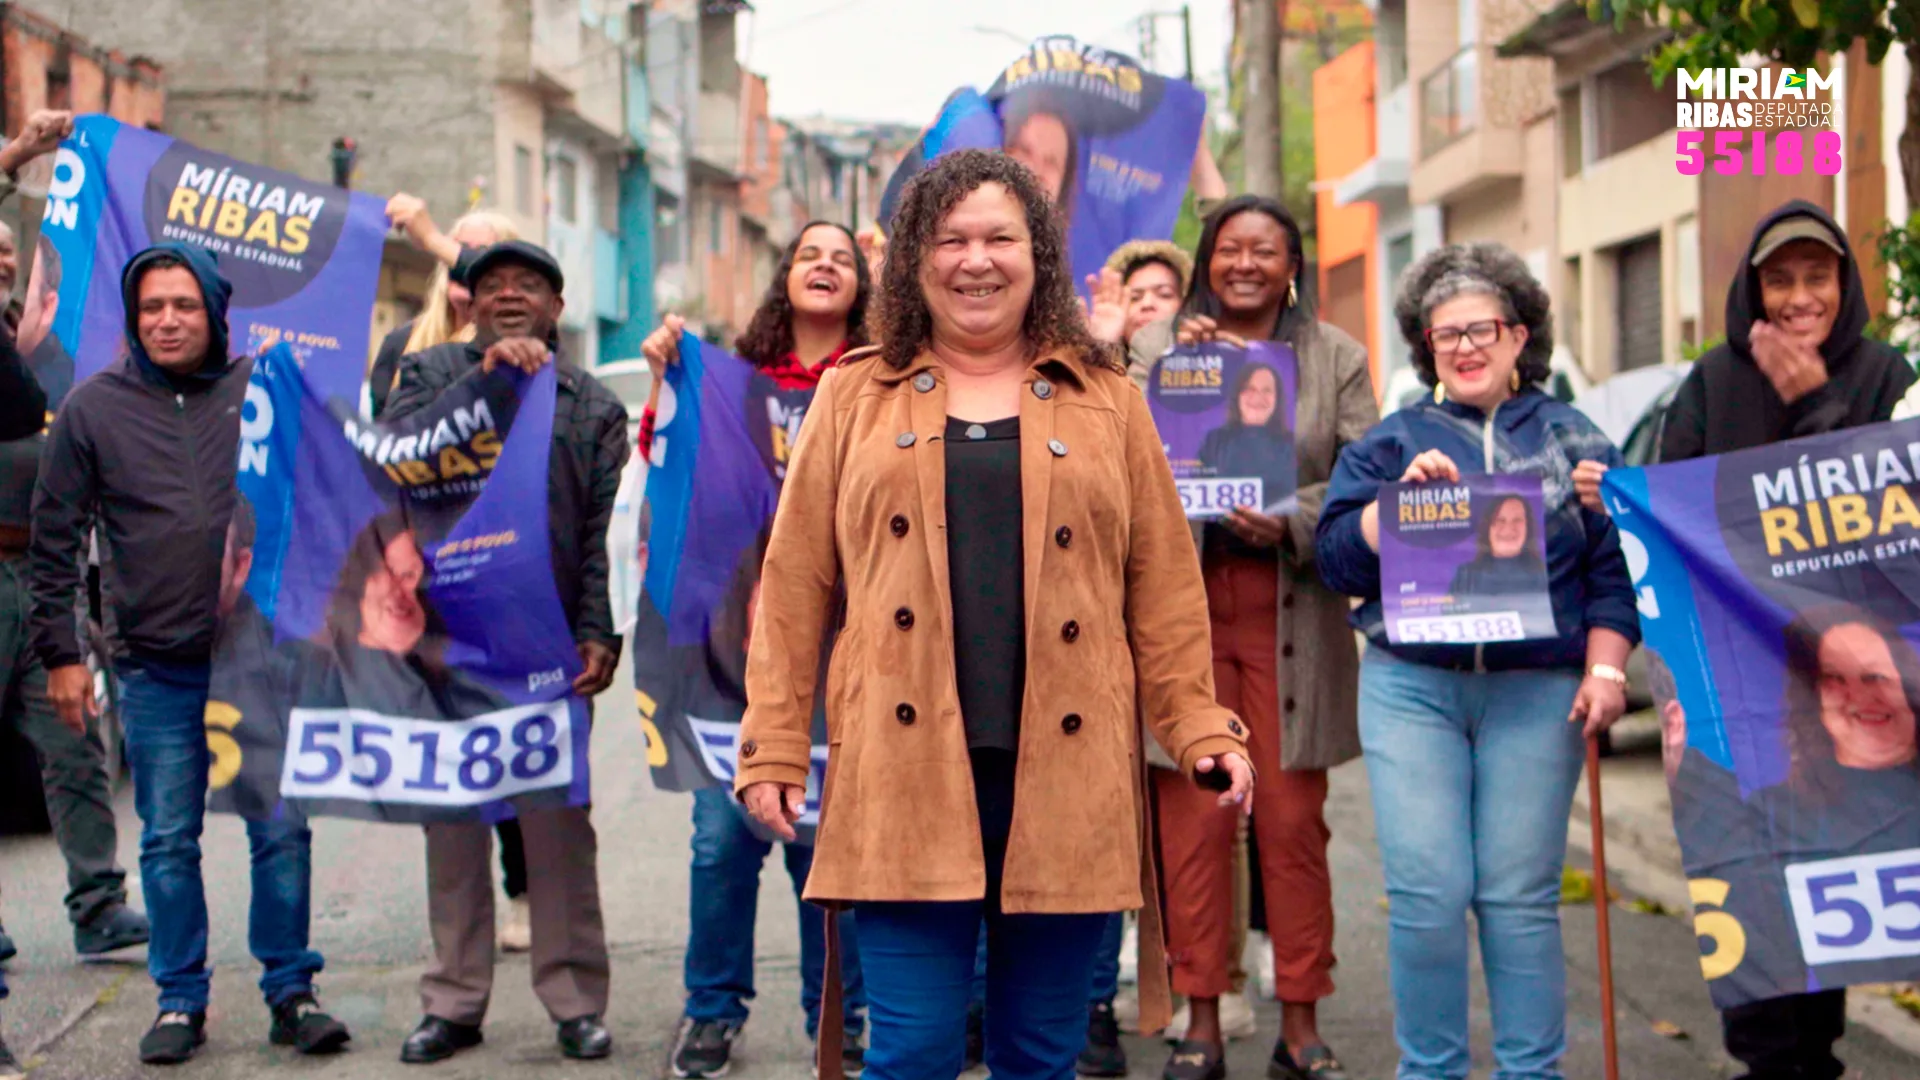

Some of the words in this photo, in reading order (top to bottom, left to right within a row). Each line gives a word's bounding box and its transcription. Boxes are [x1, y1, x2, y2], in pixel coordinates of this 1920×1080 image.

[177, 161, 326, 223] MÍRIAM
[167, 186, 313, 255] RIBAS
[162, 224, 232, 254] DEPUTADA
[234, 245, 304, 272] ESTADUAL
[1159, 368, 1223, 388] RIBAS
[1399, 501, 1472, 525] RIBAS
[1771, 547, 1870, 578] DEPUTADA
[528, 666, 565, 693] psd
[292, 713, 560, 794] 55188
